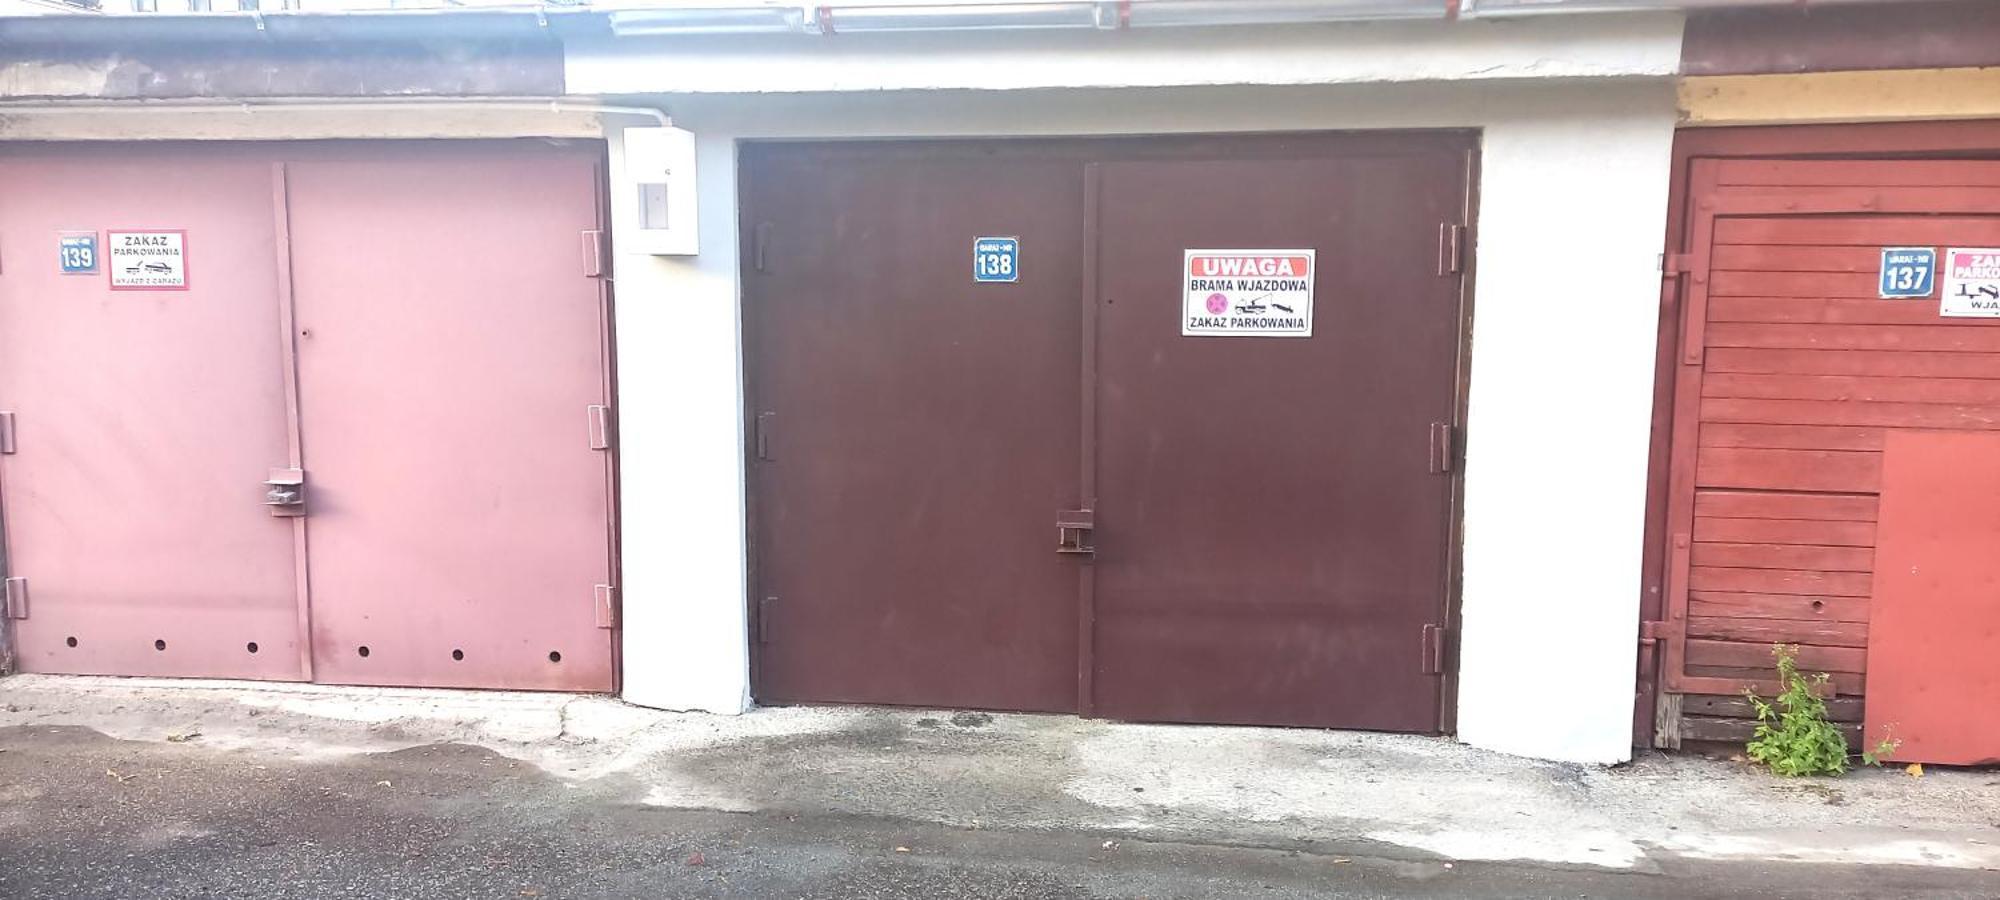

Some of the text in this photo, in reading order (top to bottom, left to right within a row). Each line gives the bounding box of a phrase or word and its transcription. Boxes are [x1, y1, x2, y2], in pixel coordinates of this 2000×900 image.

[125, 236, 167, 246] ZAKAZ
[63, 247, 93, 267] 139
[114, 248, 179, 256] PARKOWANIA
[979, 254, 1012, 275] 138
[1203, 258, 1295, 276] UWAGA
[1887, 266, 1928, 290] 137
[1191, 280, 1307, 291] BRAMA WJAZDOWA
[1190, 317, 1305, 328] ZAKAZ PARKOWANIA
